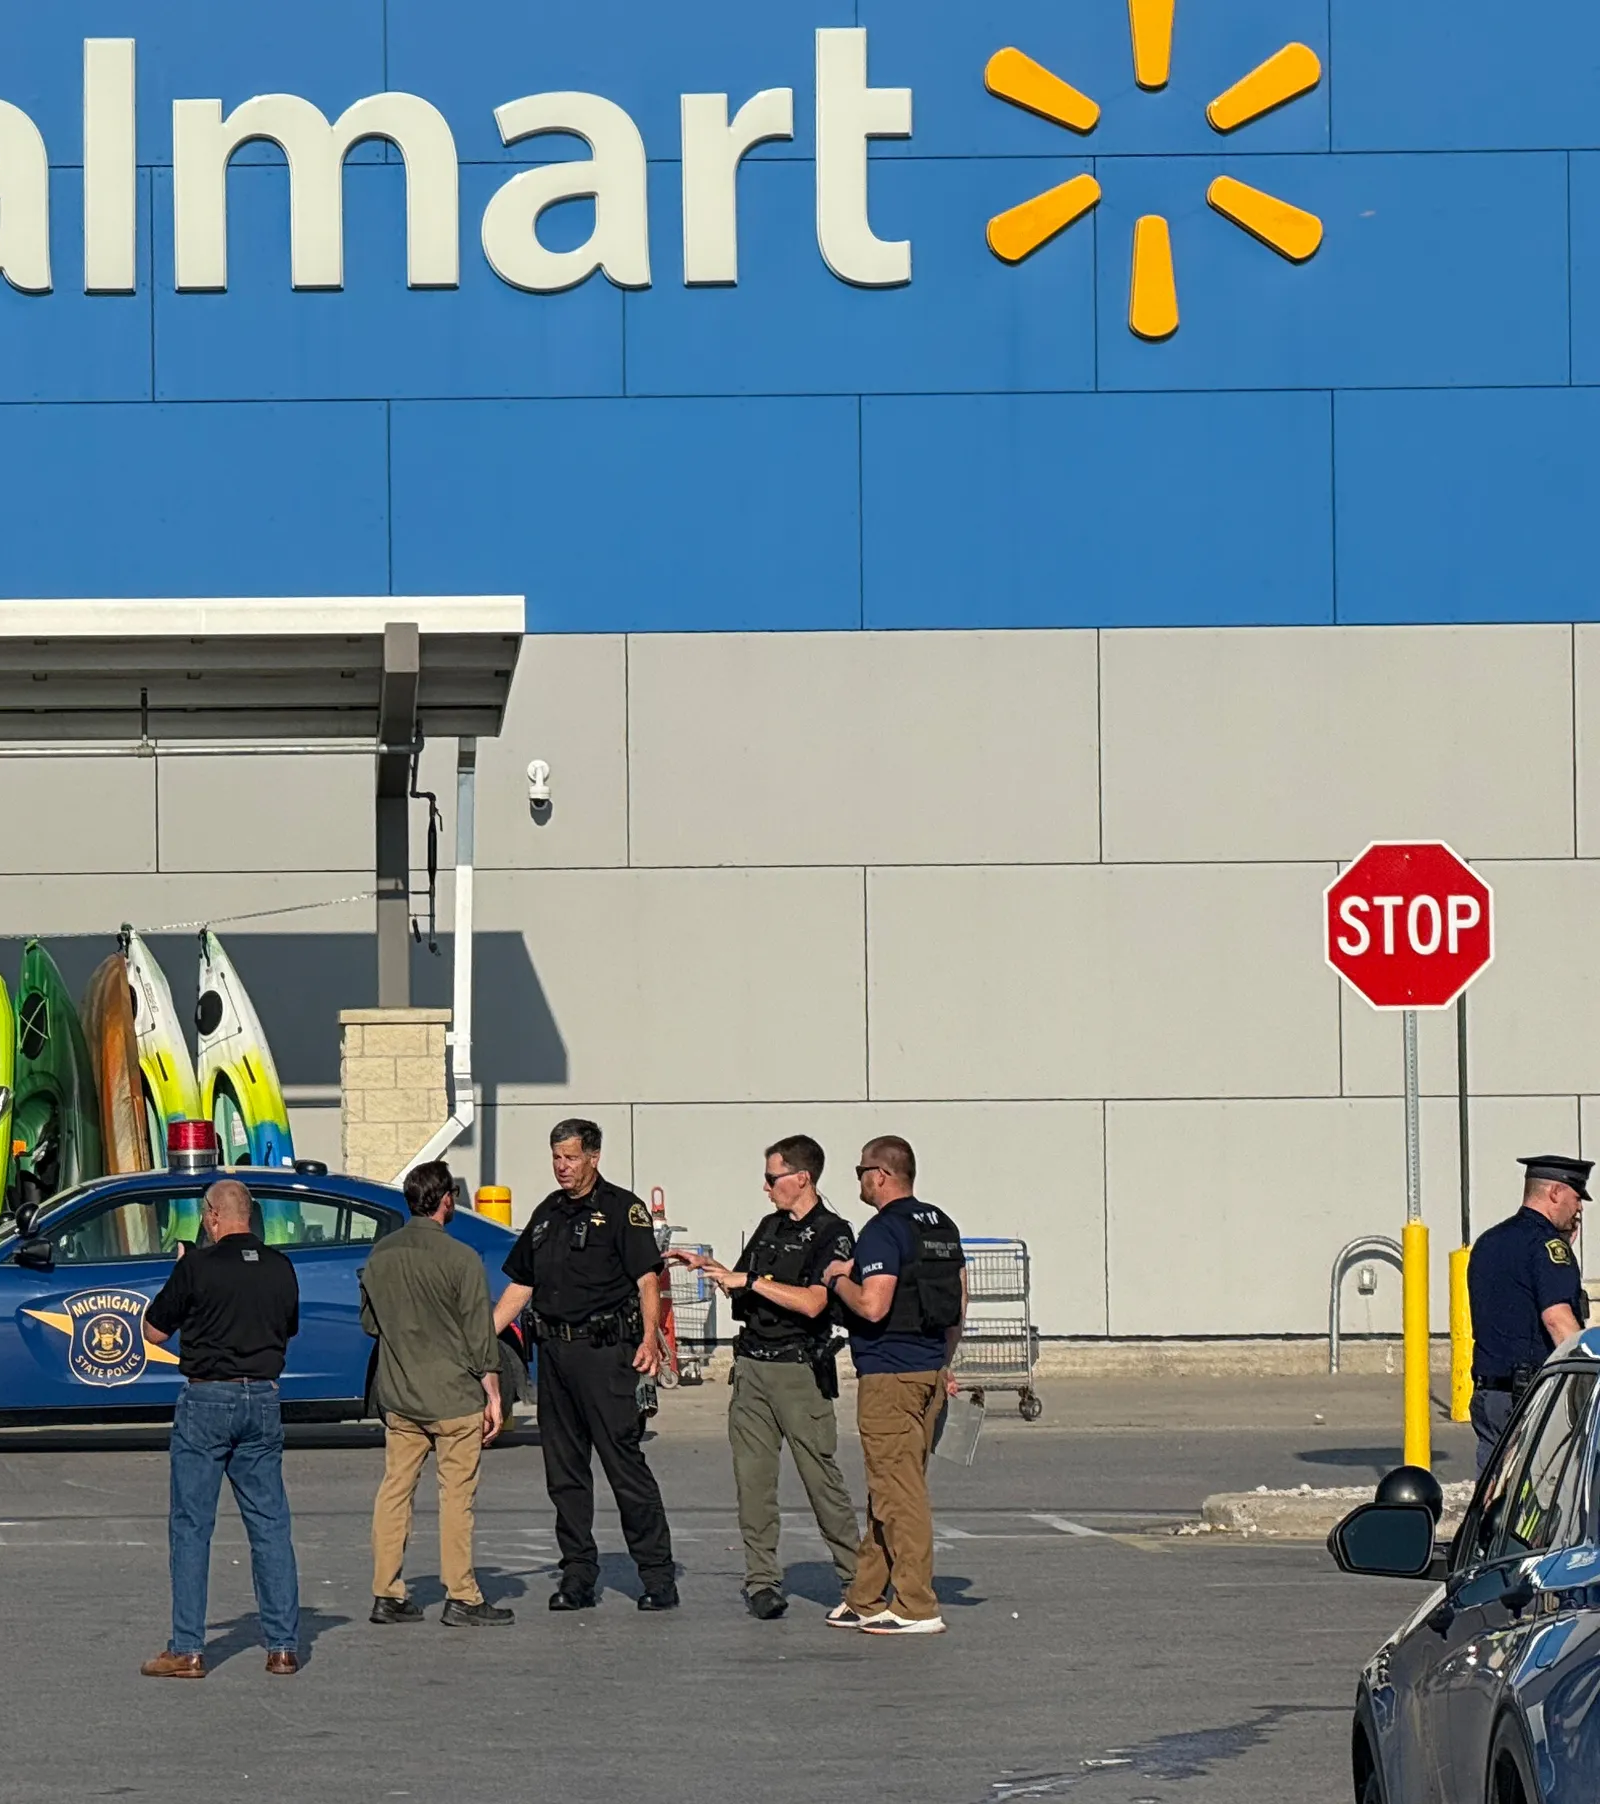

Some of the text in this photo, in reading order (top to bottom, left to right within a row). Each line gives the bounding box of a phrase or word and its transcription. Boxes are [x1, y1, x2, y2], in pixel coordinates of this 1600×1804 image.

[1337, 895, 1481, 956] STOP
[71, 1295, 141, 1318] MICHIGAN
[75, 1353, 142, 1379] STATE POLICE
